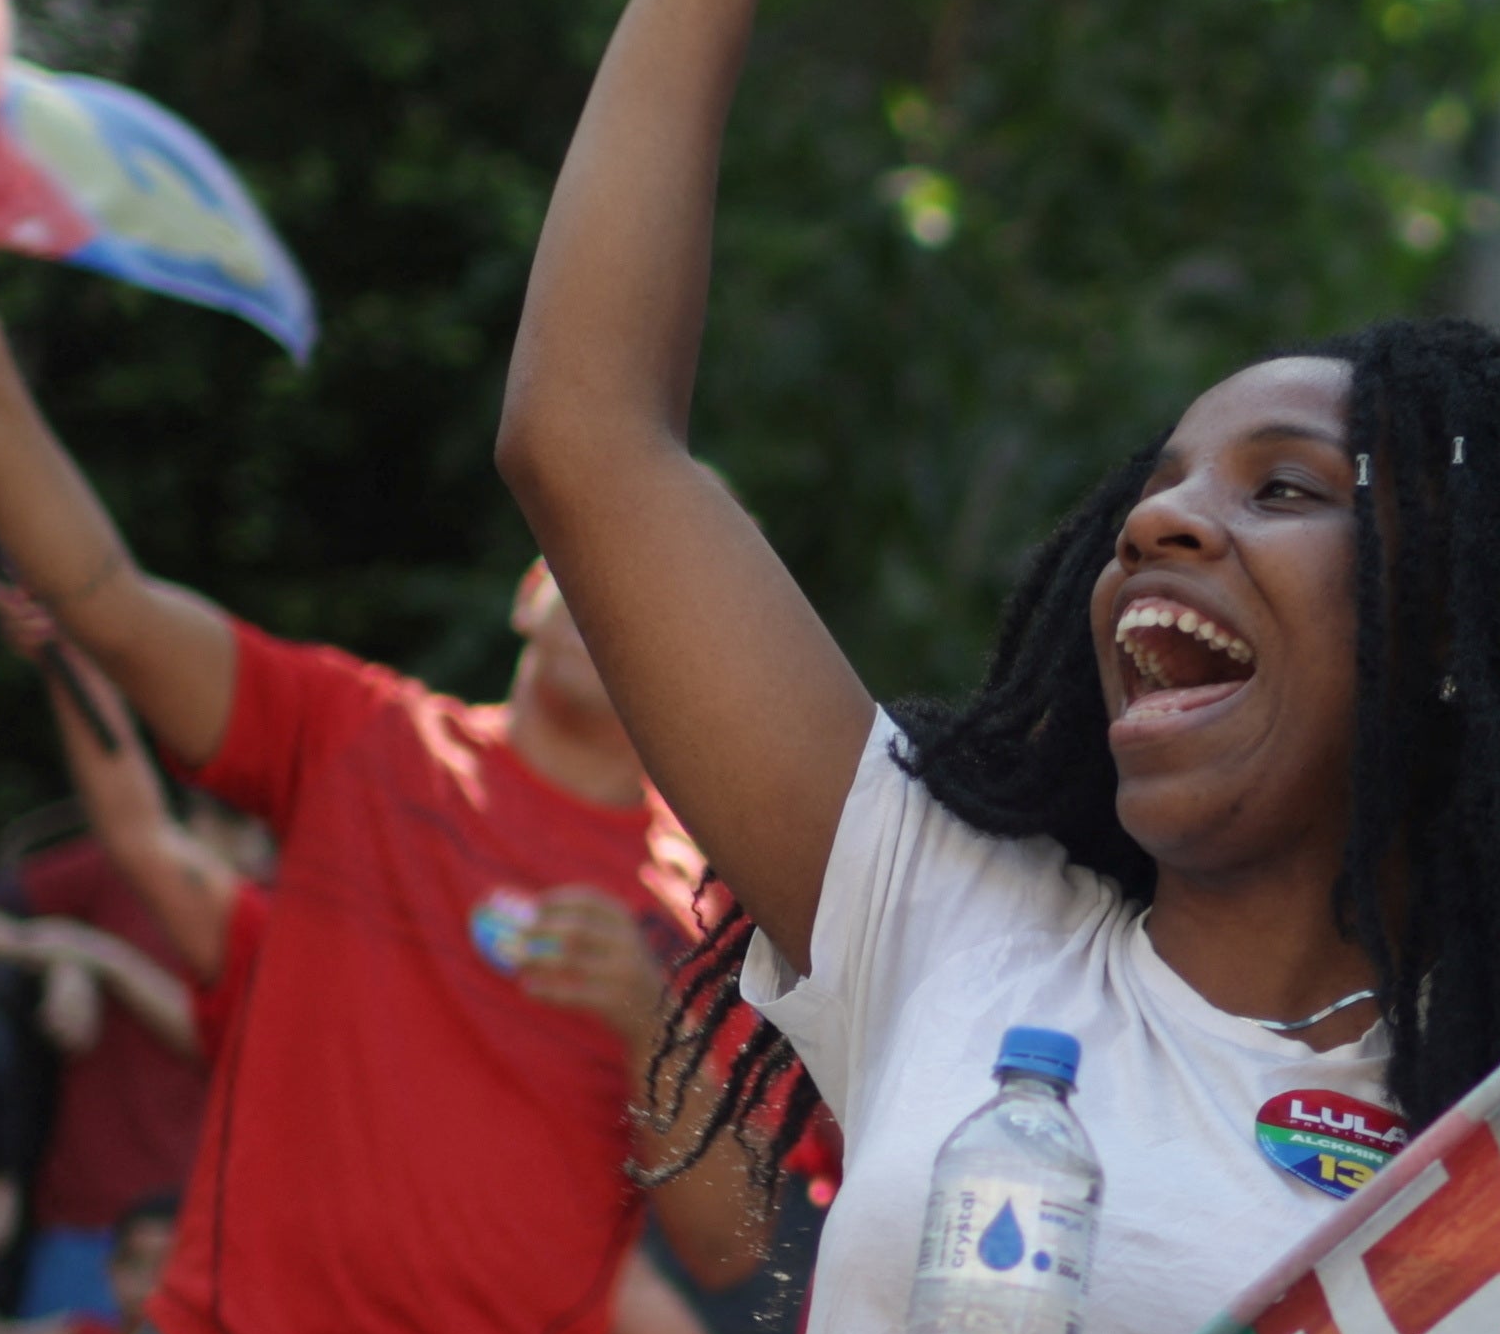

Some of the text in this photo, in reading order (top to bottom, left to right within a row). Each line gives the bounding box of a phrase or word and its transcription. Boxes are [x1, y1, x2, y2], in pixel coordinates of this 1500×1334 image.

[1289, 1098, 1409, 1144] LULA
[1289, 1133, 1384, 1164] ALCKMIN
[1318, 1153, 1377, 1190] 13
